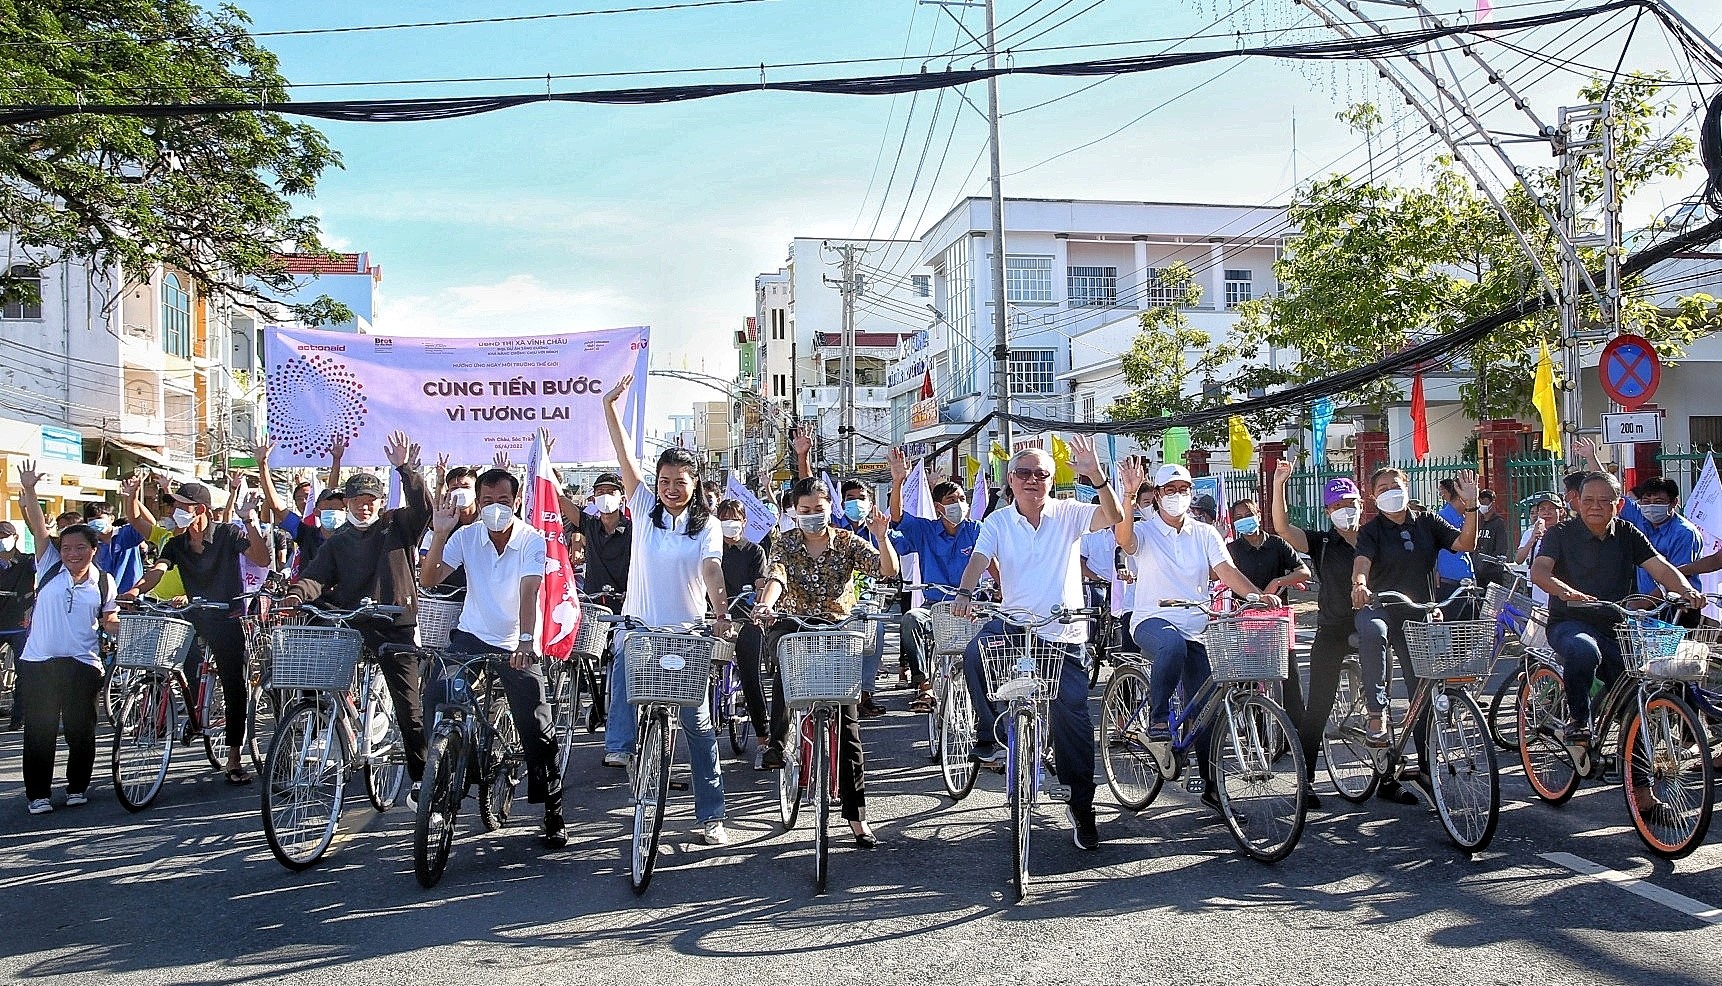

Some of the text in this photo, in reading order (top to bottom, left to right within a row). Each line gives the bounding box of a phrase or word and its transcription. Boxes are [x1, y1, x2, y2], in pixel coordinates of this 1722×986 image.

[423, 376, 603, 396] CÙNG TIẾN BƯỚC
[446, 405, 570, 421] VÌ TƯƠNG LAI
[1620, 423, 1644, 434] 200 m
